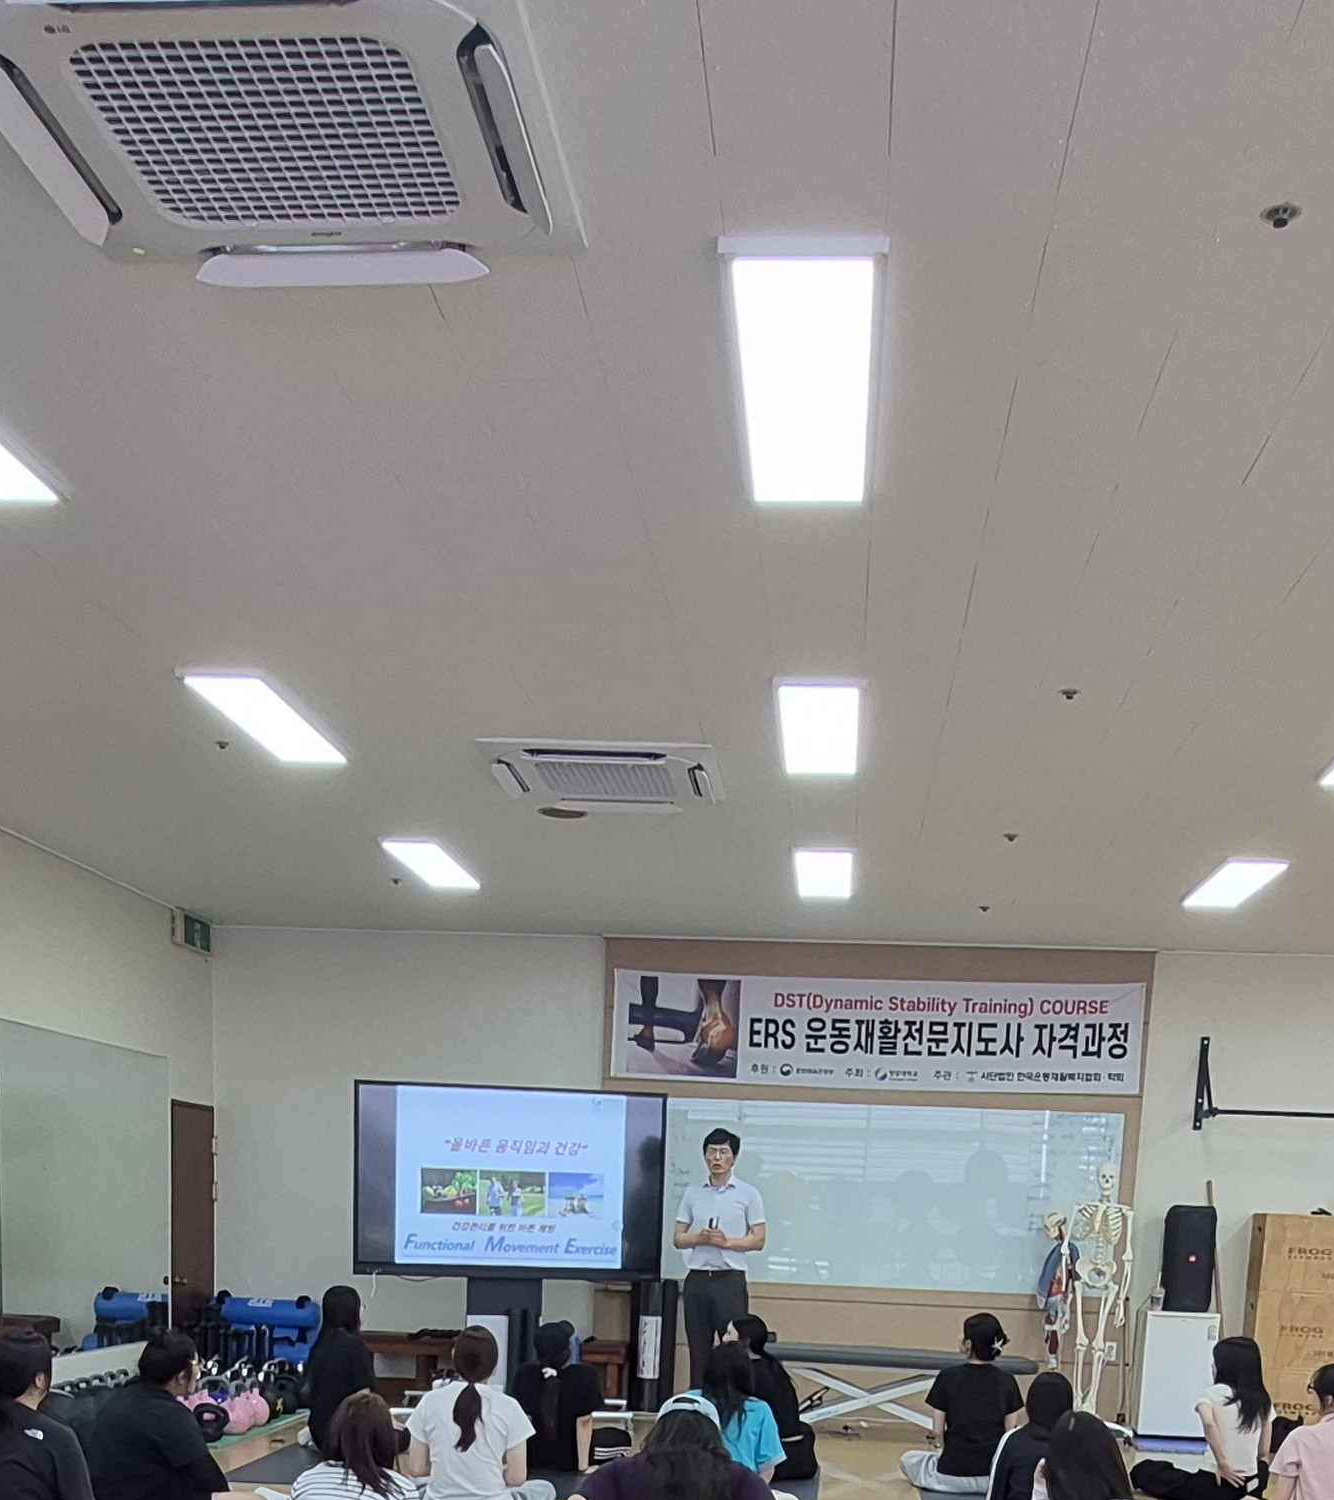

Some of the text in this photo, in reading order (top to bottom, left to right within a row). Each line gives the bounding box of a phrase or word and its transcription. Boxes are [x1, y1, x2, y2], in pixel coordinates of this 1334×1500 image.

[774, 992, 1109, 1018] DST(Dynamic Stability Training) COURSE
[748, 1017, 1130, 1060] ERS 운동재활전문지도사 자격과정
[495, 1139, 551, 1155] 움직임과
[403, 1233, 618, 1256] Functional Movement Exercise
[1288, 1247, 1332, 1256] FROG
[1280, 1325, 1324, 1334] FROG
